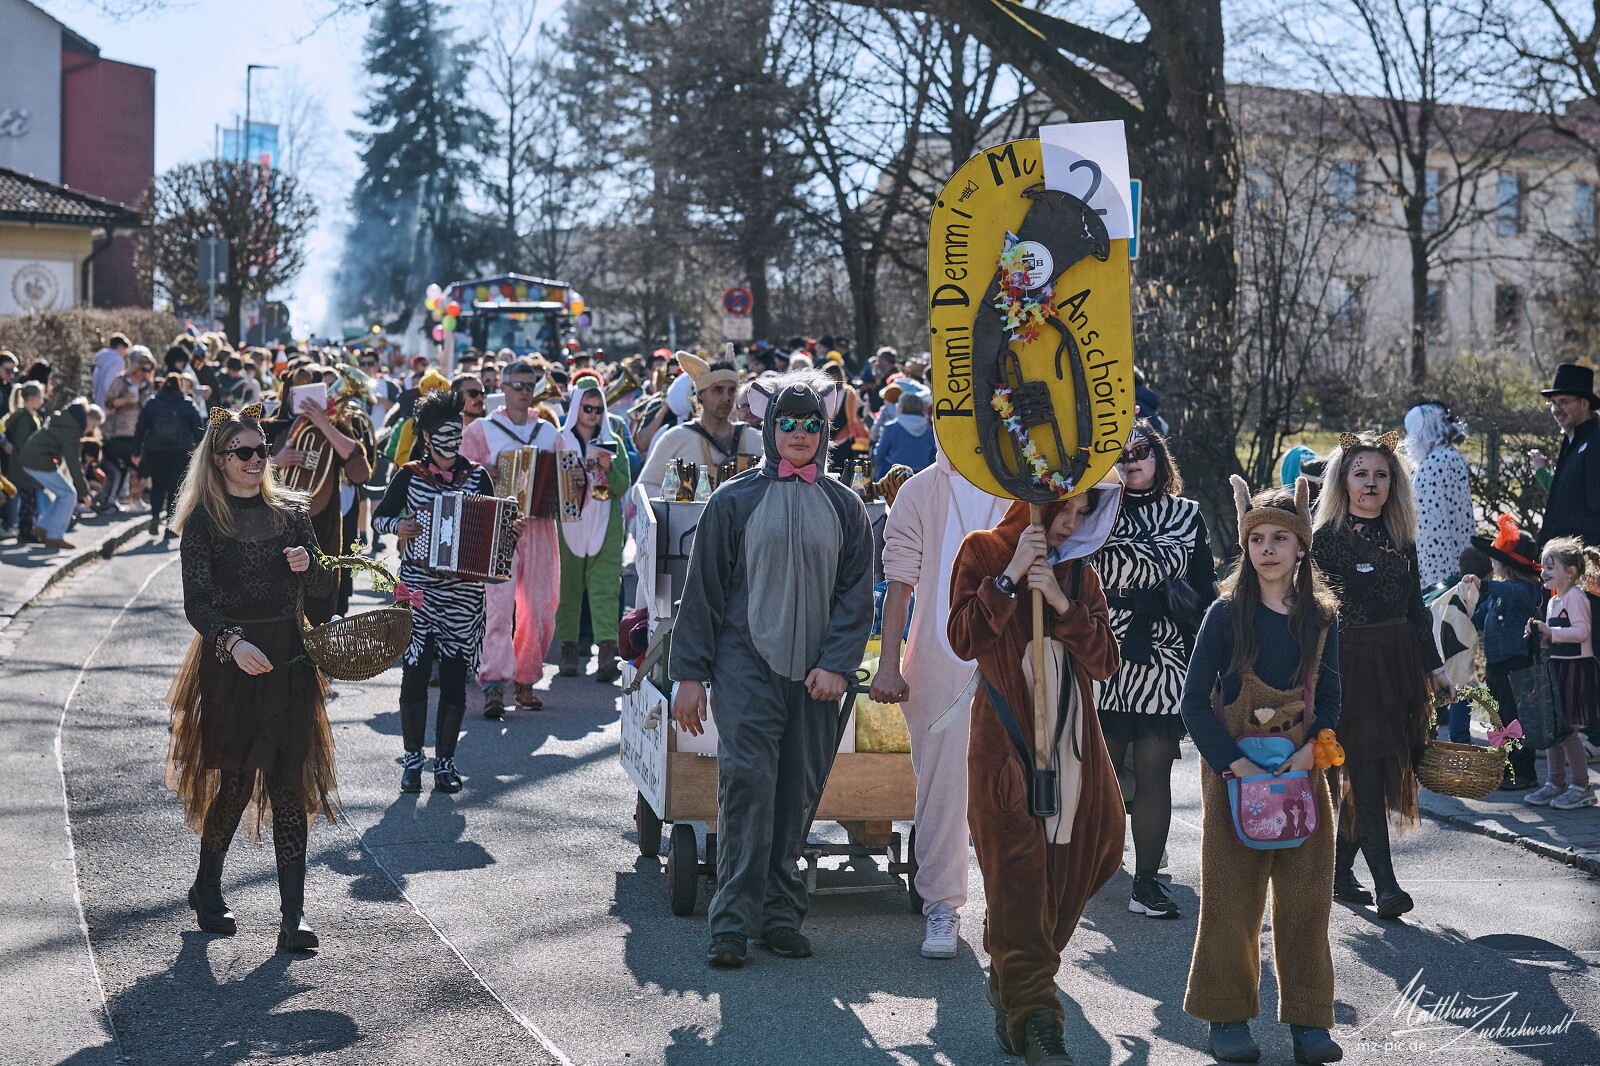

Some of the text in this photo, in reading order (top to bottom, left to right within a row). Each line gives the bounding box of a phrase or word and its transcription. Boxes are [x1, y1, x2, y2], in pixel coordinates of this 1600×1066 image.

[987, 144, 1044, 186] Mu
[1069, 159, 1107, 216] 2
[930, 200, 973, 420] Remmi Demmi
[1057, 288, 1127, 454] Anschöring
